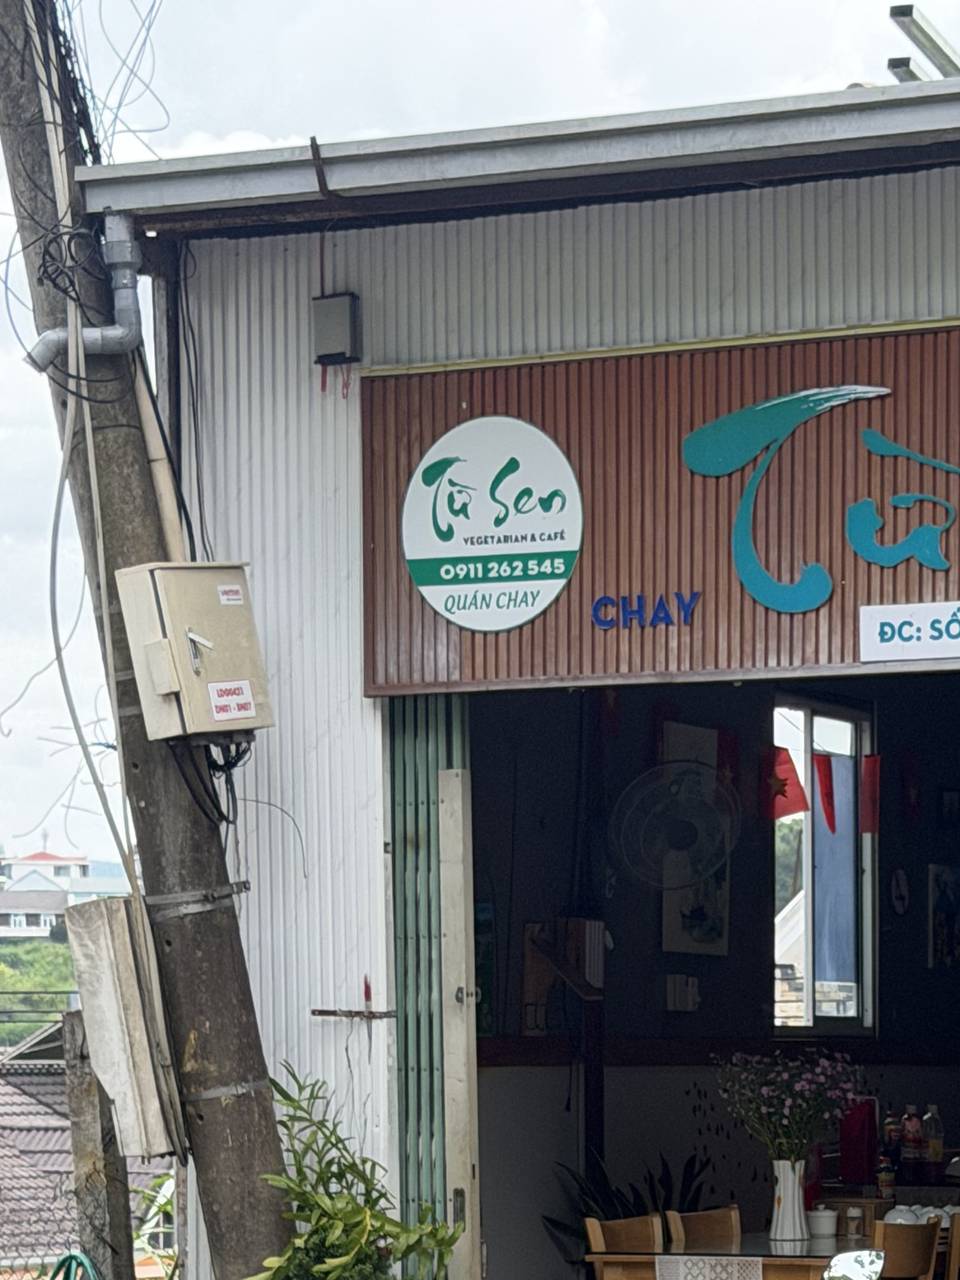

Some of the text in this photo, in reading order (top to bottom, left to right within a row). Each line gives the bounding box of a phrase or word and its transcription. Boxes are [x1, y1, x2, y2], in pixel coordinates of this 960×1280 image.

[489, 456, 567, 528] Sen
[463, 529, 566, 546] VEGETARIAN & CAFÉ
[440, 558, 566, 580] 0911 262 545
[443, 589, 541, 615] QUÁN CHAY
[591, 591, 702, 631] CHAY
[878, 620, 922, 643] ĐC:
